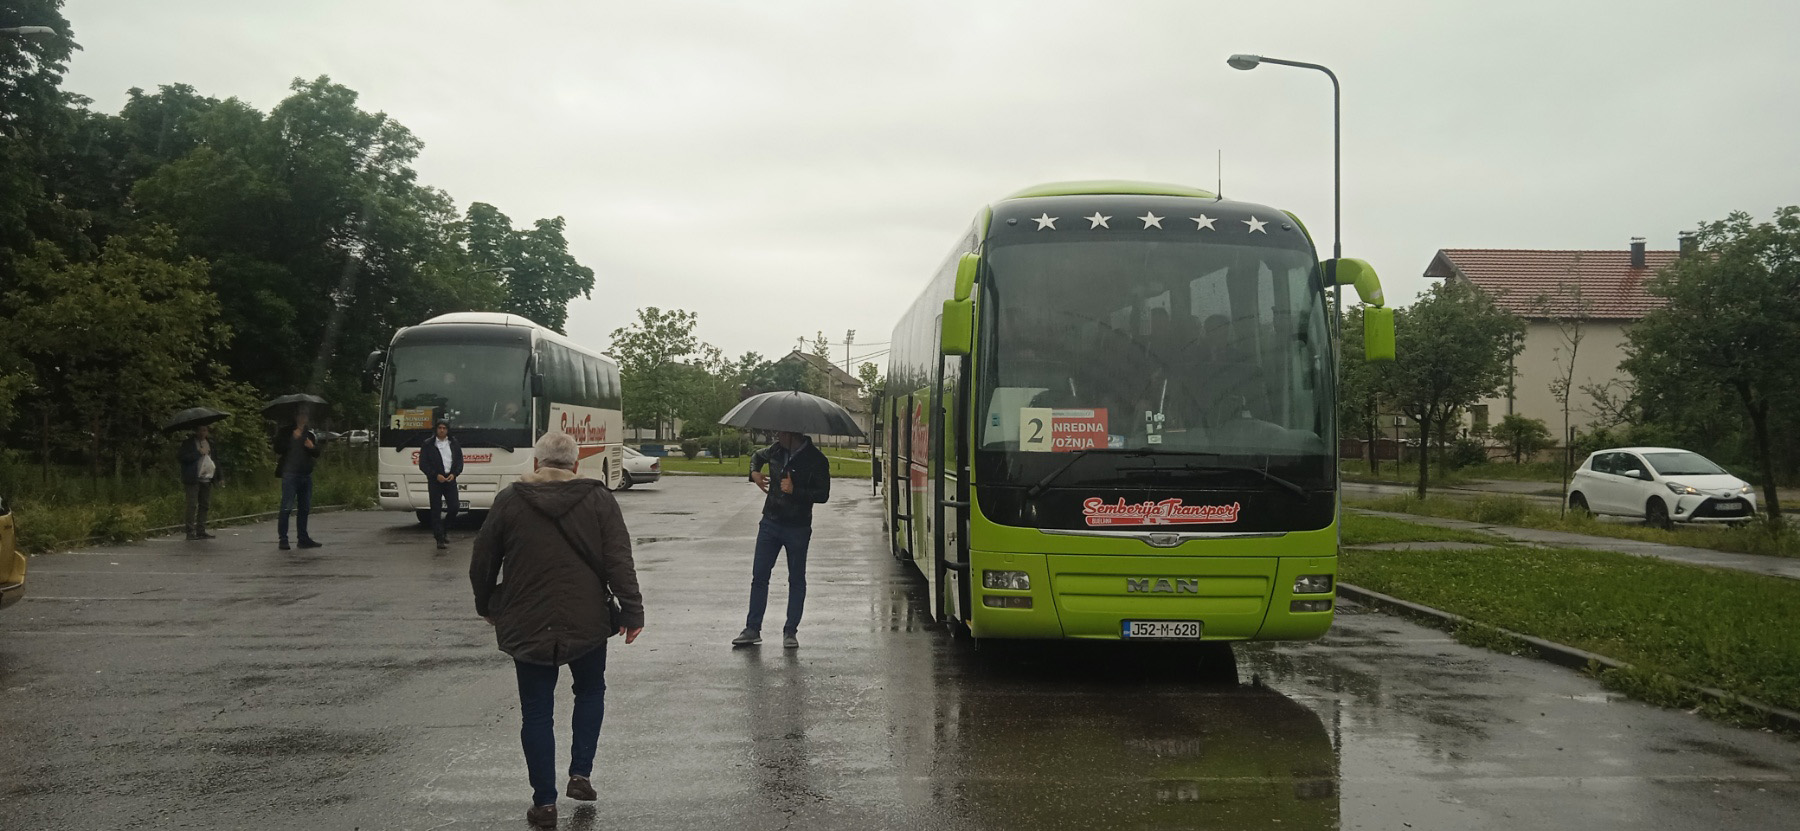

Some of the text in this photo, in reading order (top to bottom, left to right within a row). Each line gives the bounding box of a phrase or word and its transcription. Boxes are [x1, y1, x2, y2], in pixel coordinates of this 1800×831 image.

[1027, 418, 1044, 443] 2
[1052, 423, 1104, 433] NREDNA
[1083, 497, 1240, 520] Semberija Transport
[1127, 577, 1198, 593] MAN
[1132, 623, 1198, 636] J52-M-628
